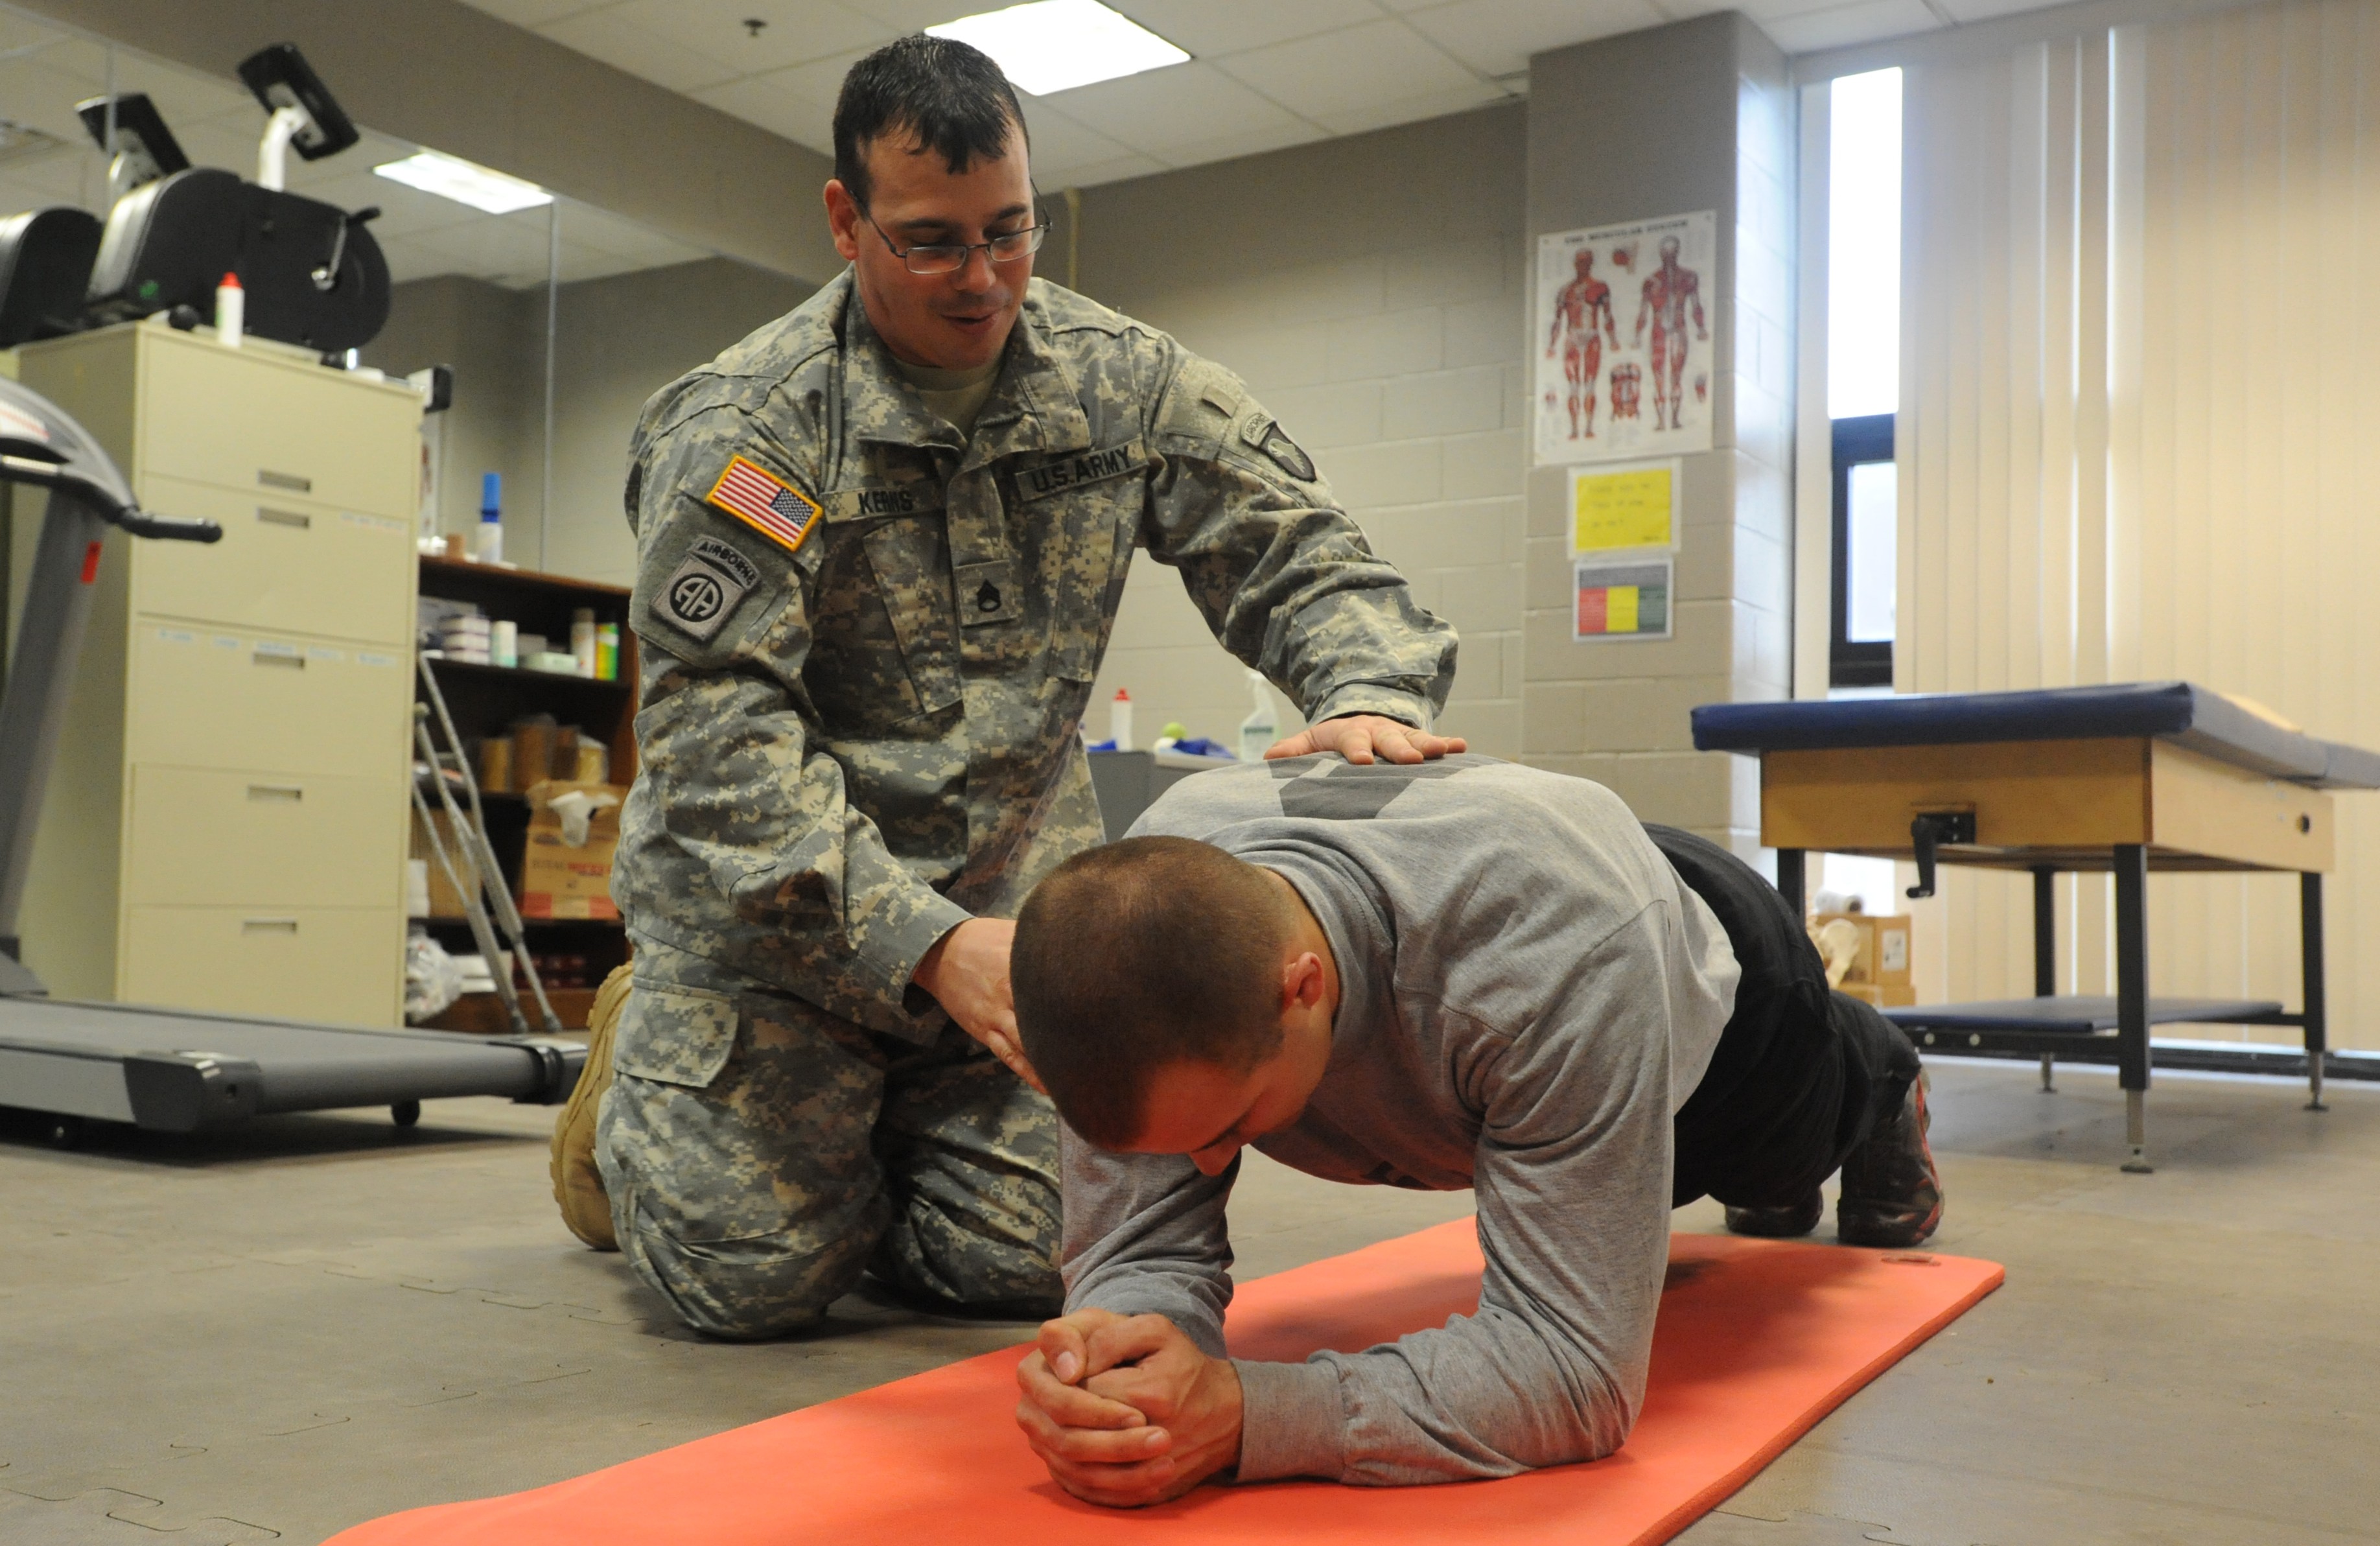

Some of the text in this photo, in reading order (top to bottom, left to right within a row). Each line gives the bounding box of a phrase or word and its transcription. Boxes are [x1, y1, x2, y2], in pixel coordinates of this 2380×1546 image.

[1075, 445, 1131, 483] ARMY
[858, 490, 913, 515] KERNS
[698, 541, 756, 585] AIRBORNE
